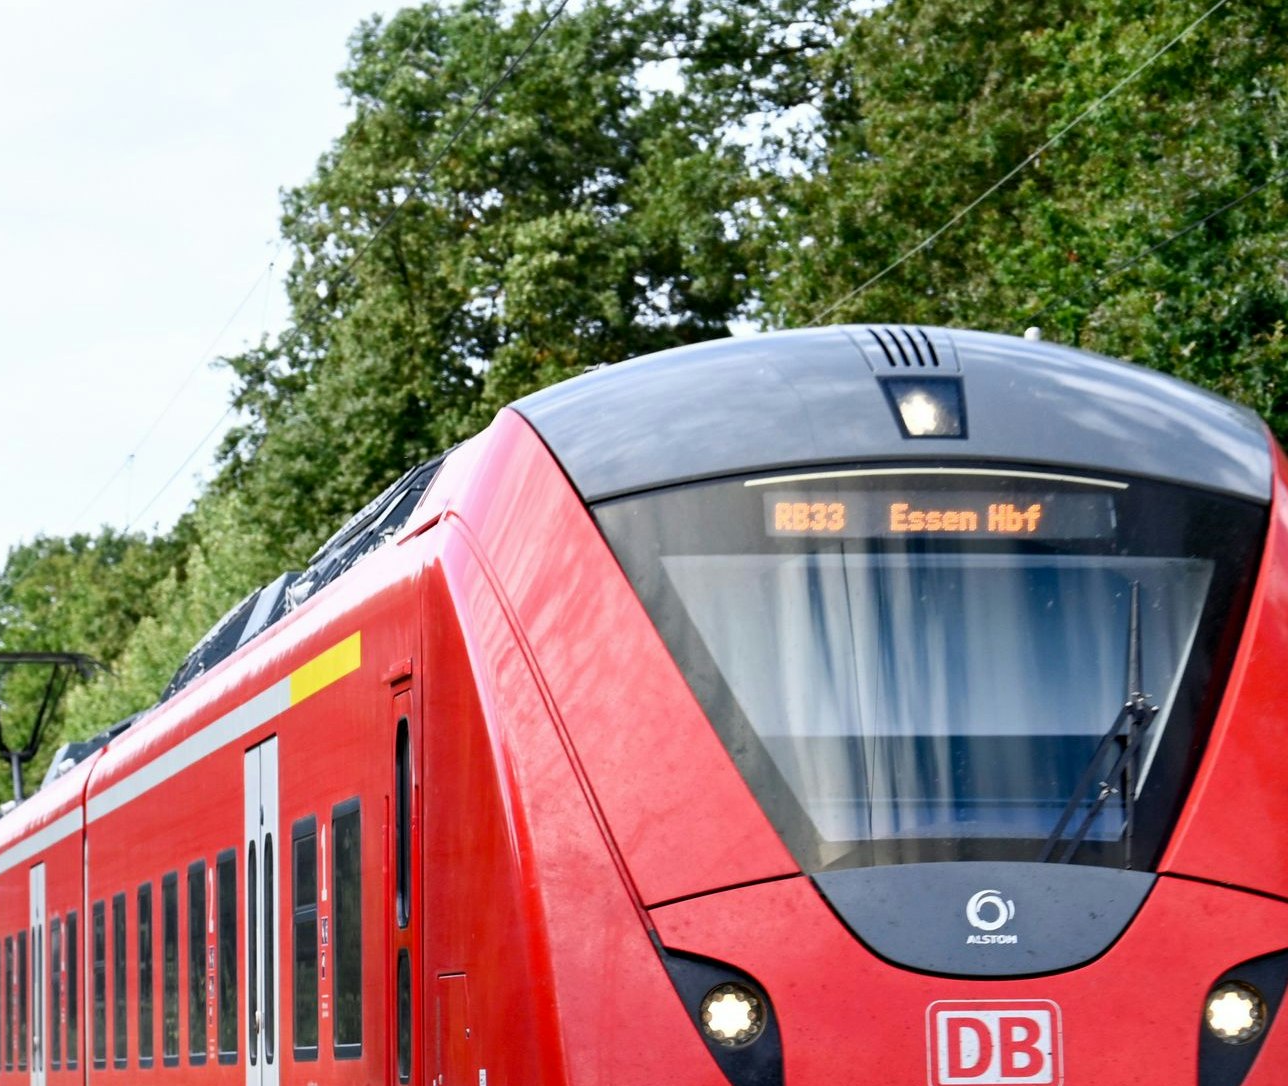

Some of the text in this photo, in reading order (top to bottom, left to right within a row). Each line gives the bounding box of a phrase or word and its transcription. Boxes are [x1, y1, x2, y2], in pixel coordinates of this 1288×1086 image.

[775, 502, 1041, 532] RB33 Essen Hbf
[966, 934, 1018, 945] ALSTOM
[945, 1015, 1046, 1080] DB
